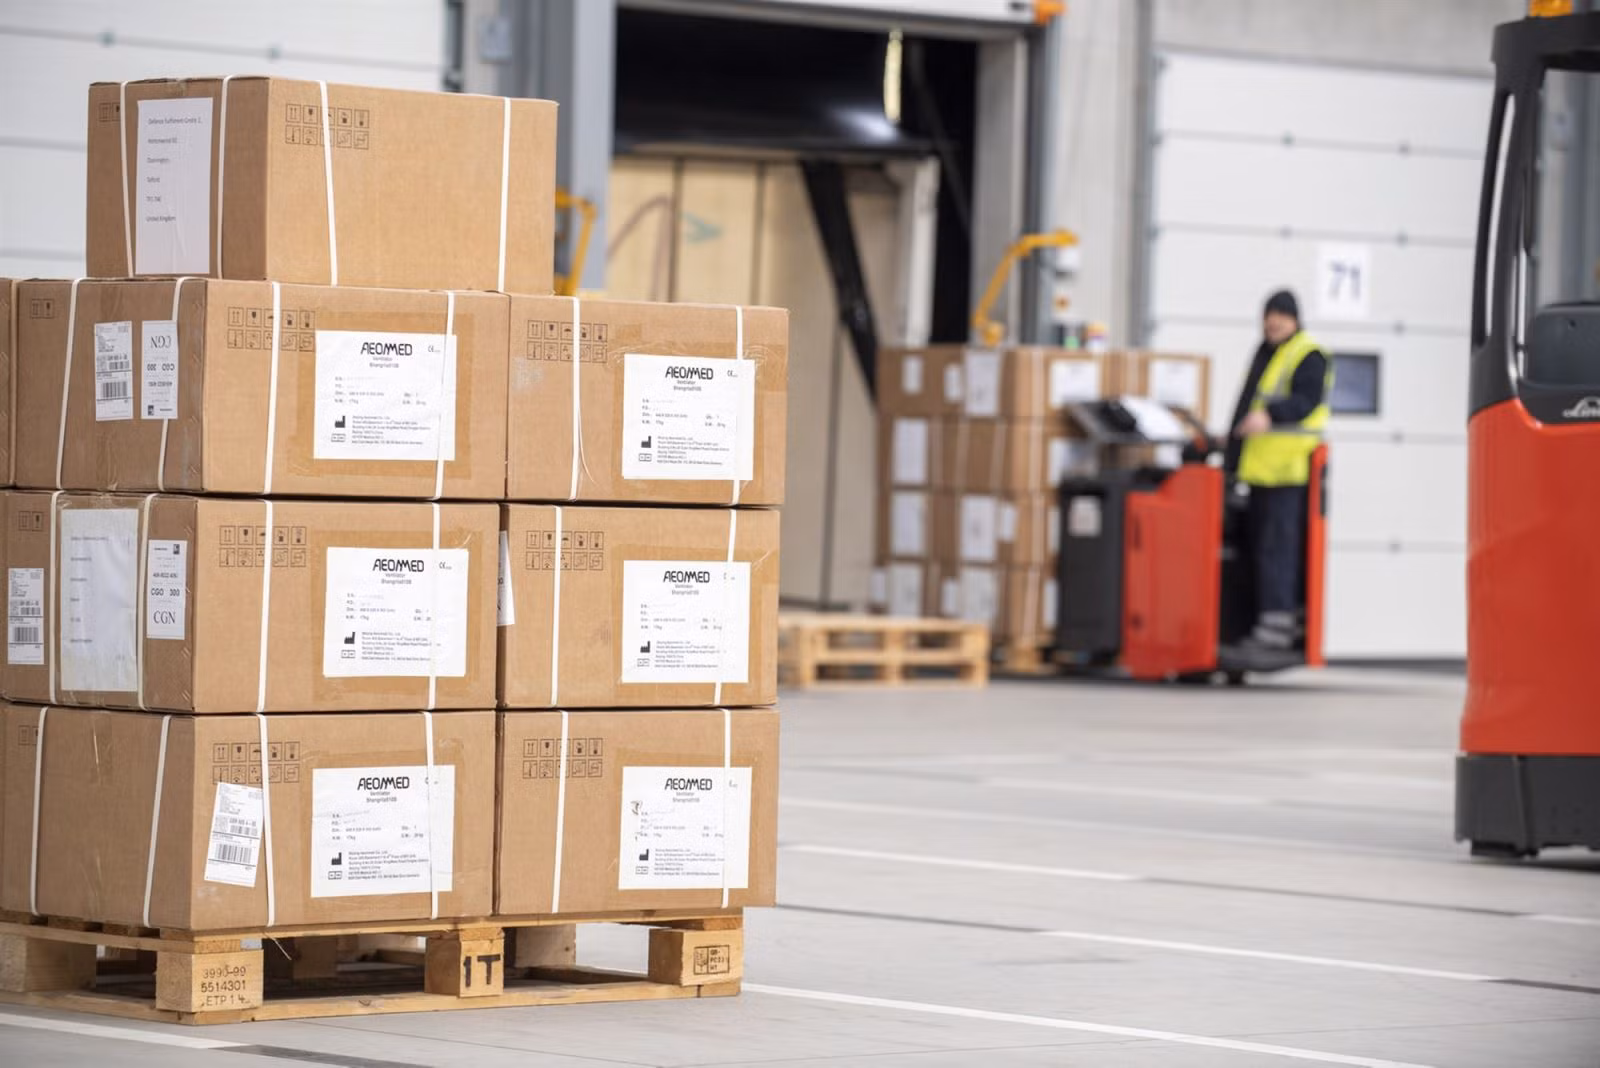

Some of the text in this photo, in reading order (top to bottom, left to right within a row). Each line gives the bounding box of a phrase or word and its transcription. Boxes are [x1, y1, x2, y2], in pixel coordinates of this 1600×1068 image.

[1329, 260, 1361, 299] 71
[151, 336, 172, 348] CGN
[151, 588, 180, 596] CGO 300
[153, 610, 176, 624] CGN
[463, 954, 501, 988] 1T
[201, 980, 246, 993] 5514301
